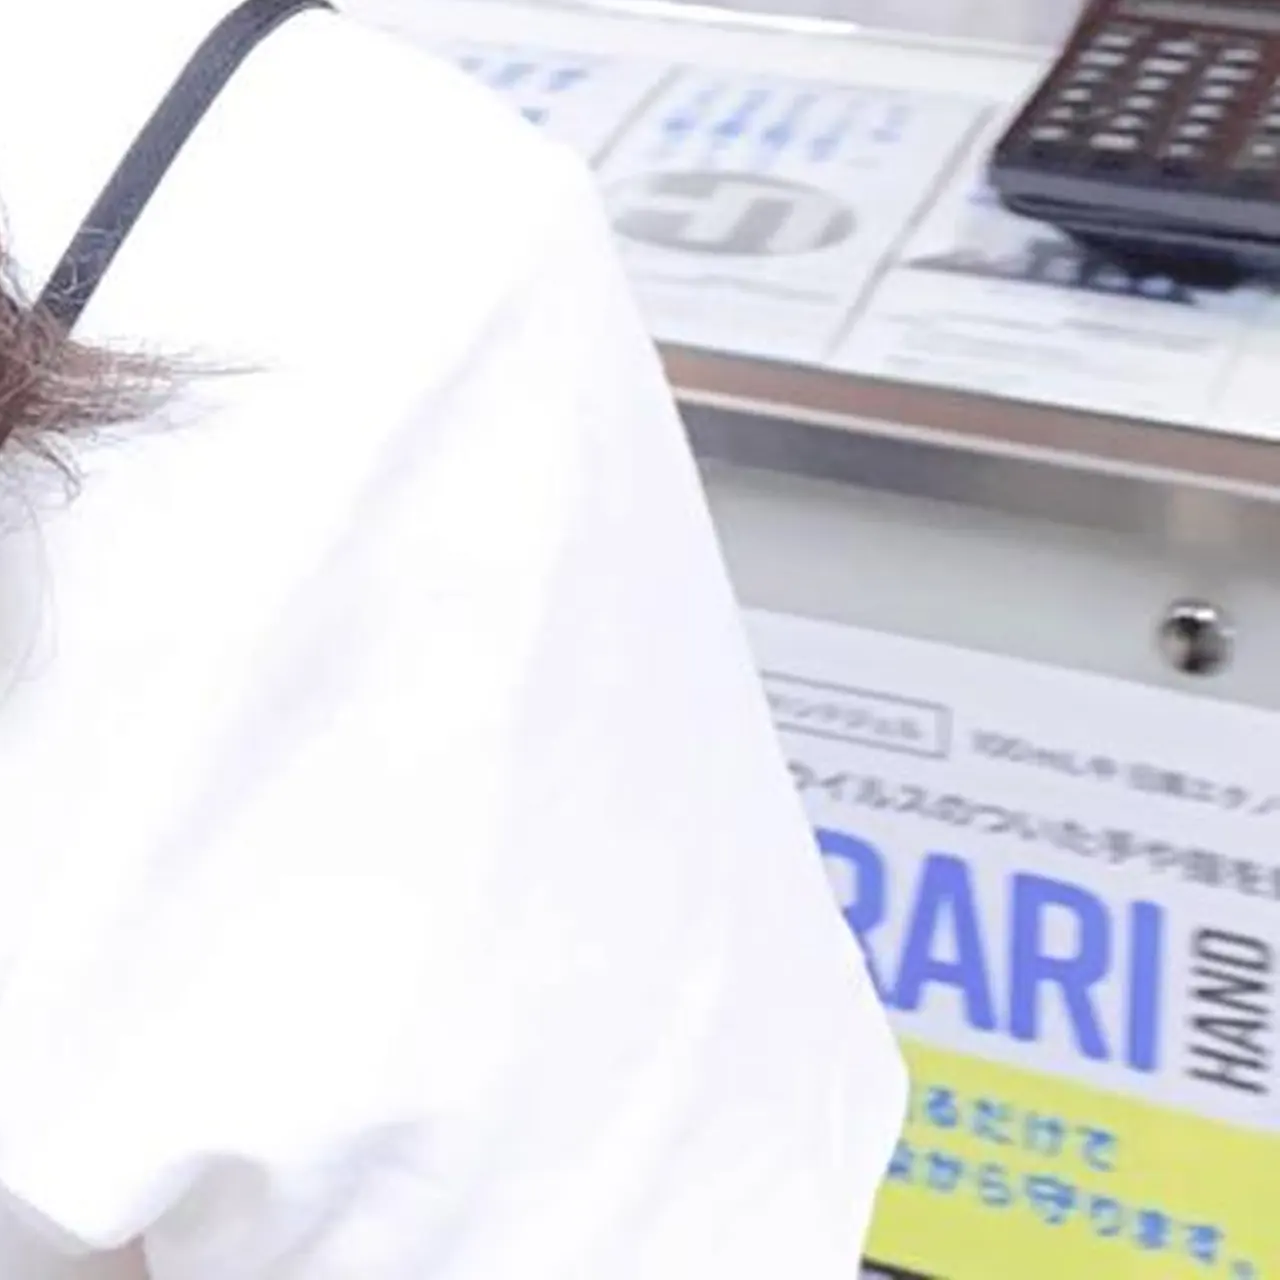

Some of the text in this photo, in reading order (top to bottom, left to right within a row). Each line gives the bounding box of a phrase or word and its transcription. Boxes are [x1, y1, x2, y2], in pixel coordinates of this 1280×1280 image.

[1188, 926, 1271, 1097] HAND
[907, 1082, 1119, 1172] るだけで
